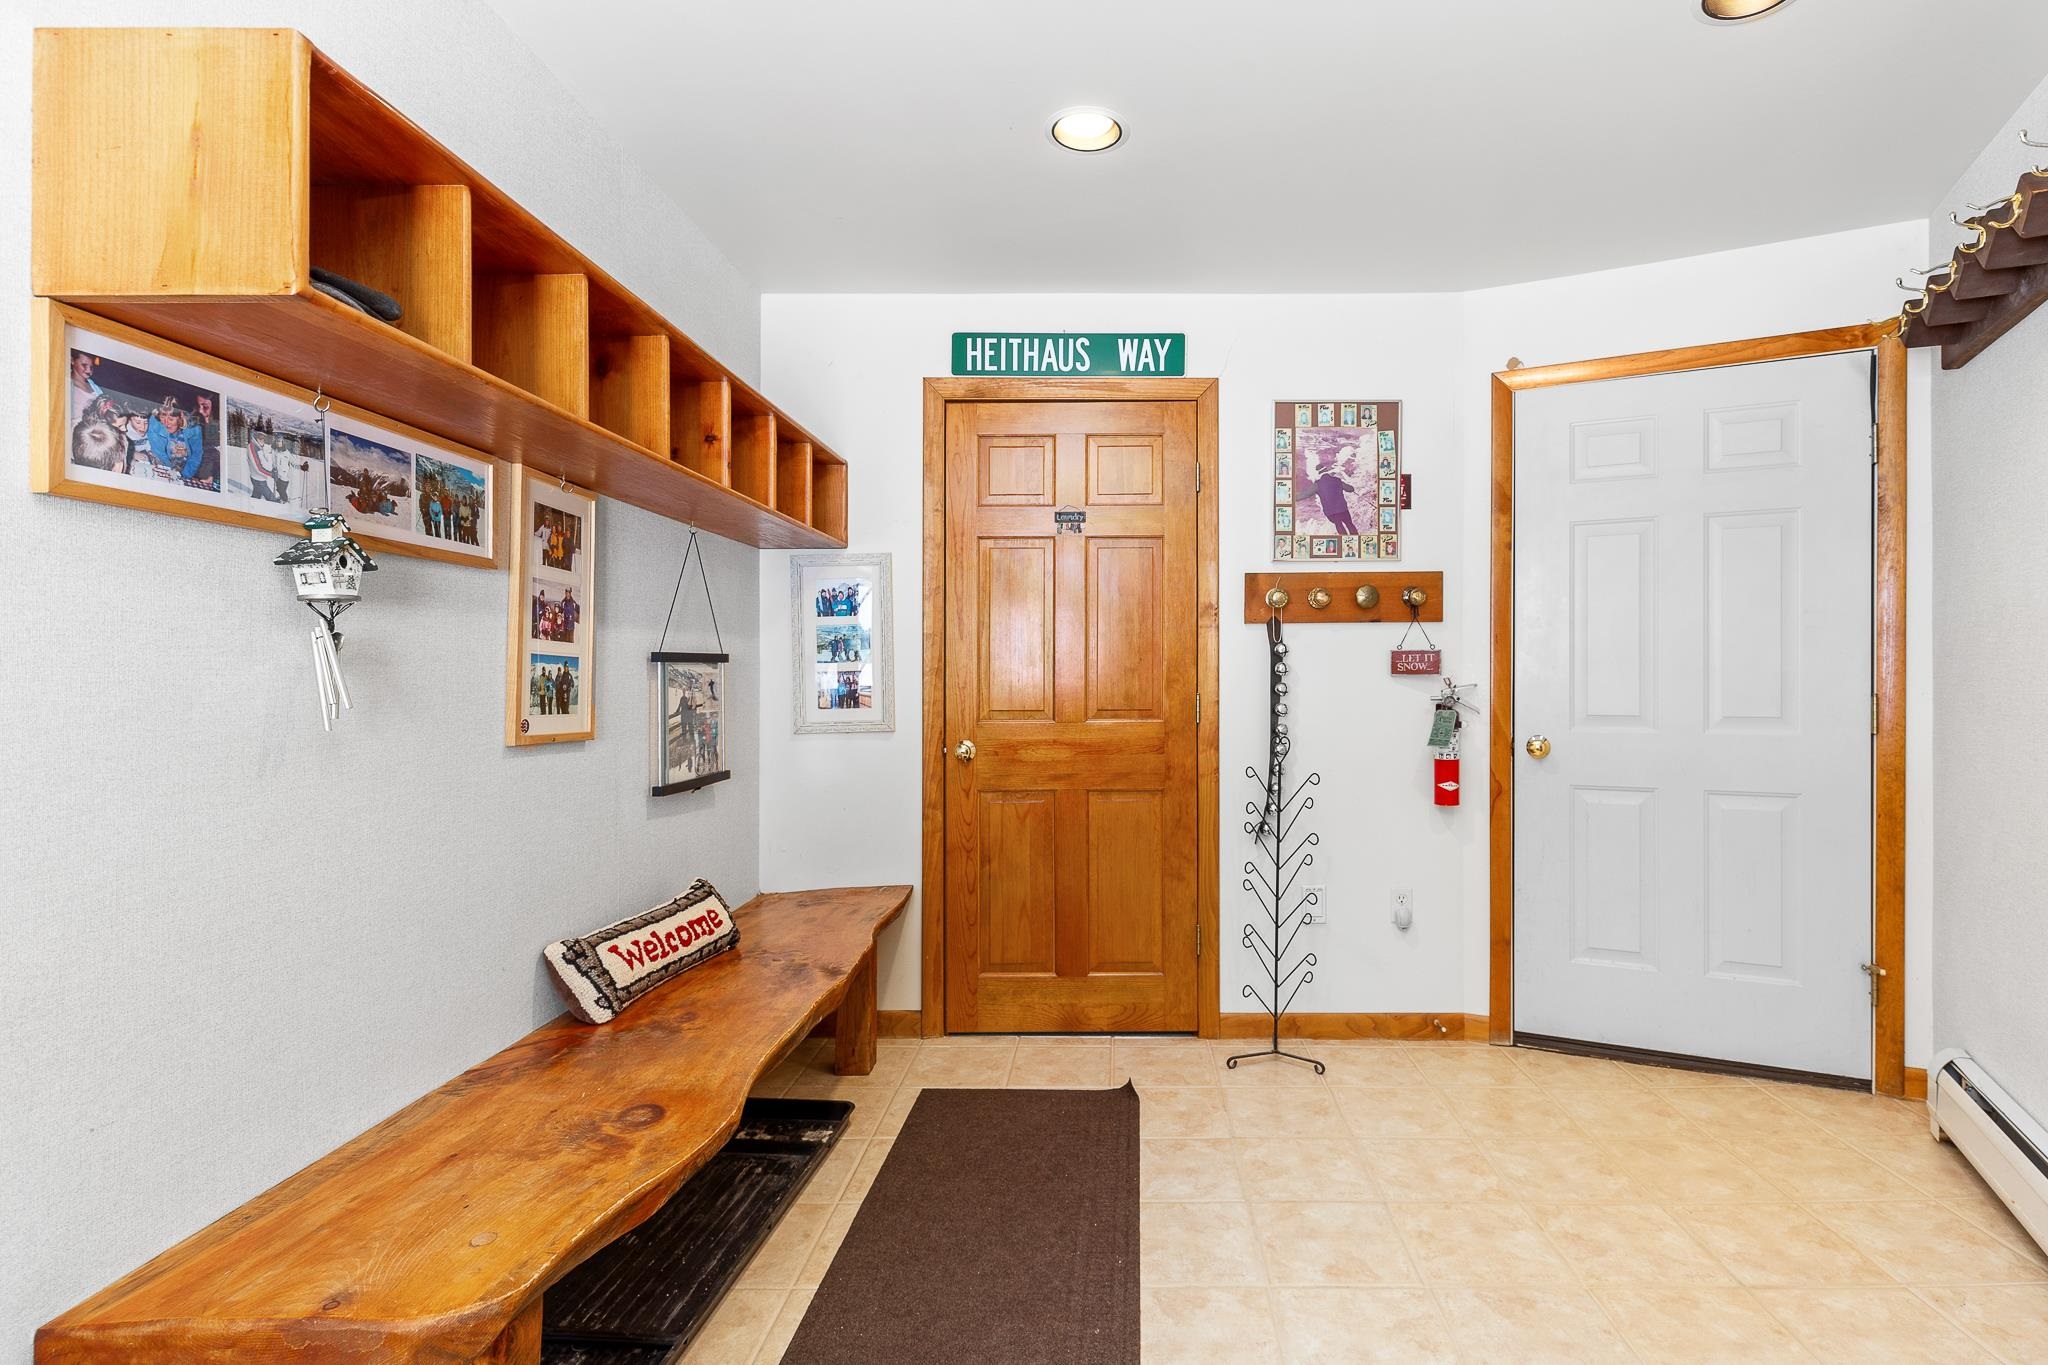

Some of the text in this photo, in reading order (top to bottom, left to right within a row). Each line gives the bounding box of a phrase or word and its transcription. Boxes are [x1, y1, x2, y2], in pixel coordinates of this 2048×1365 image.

[966, 337, 1172, 372] HEITHAUS WAY
[1056, 513, 1084, 521] Laundry
[1424, 653, 1435, 662] IT
[608, 909, 724, 971] Welcome
